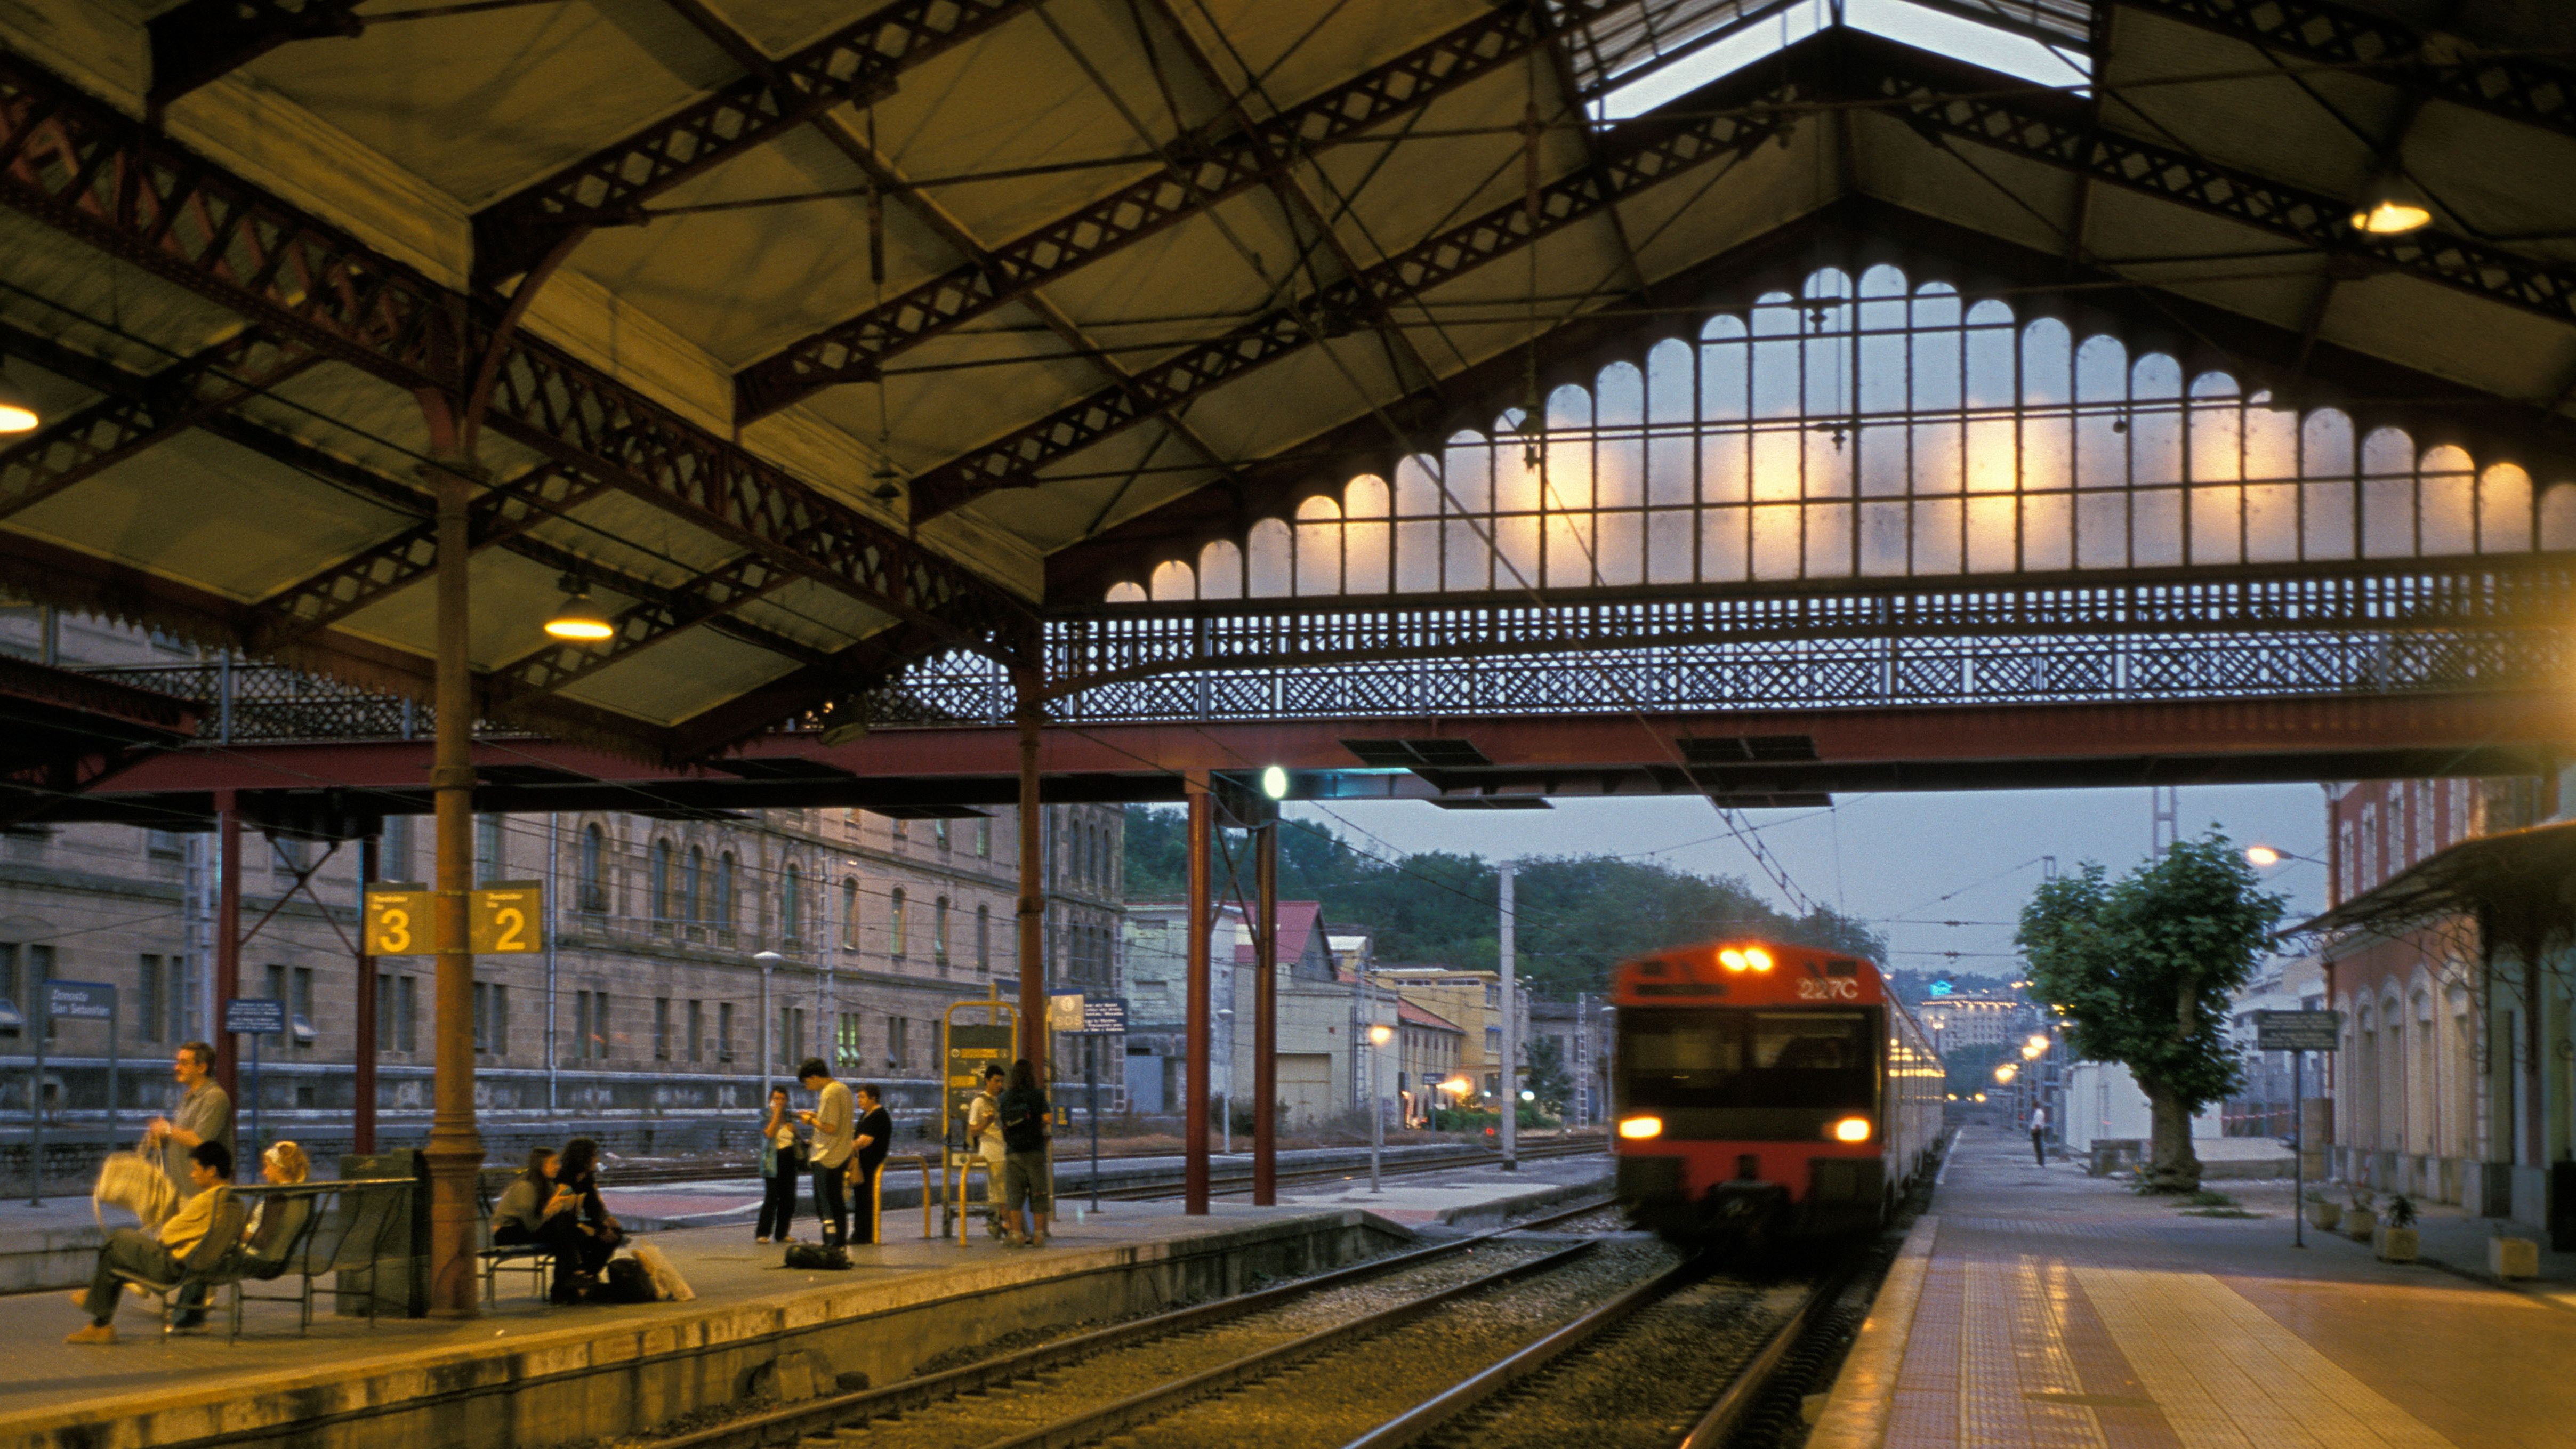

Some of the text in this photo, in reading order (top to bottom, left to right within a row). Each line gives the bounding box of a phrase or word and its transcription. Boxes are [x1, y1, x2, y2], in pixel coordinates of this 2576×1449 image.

[380, 908, 411, 952] 3
[495, 907, 526, 951] 2
[51, 1002, 69, 1014] San
[1056, 1015, 1082, 1026] SOS
